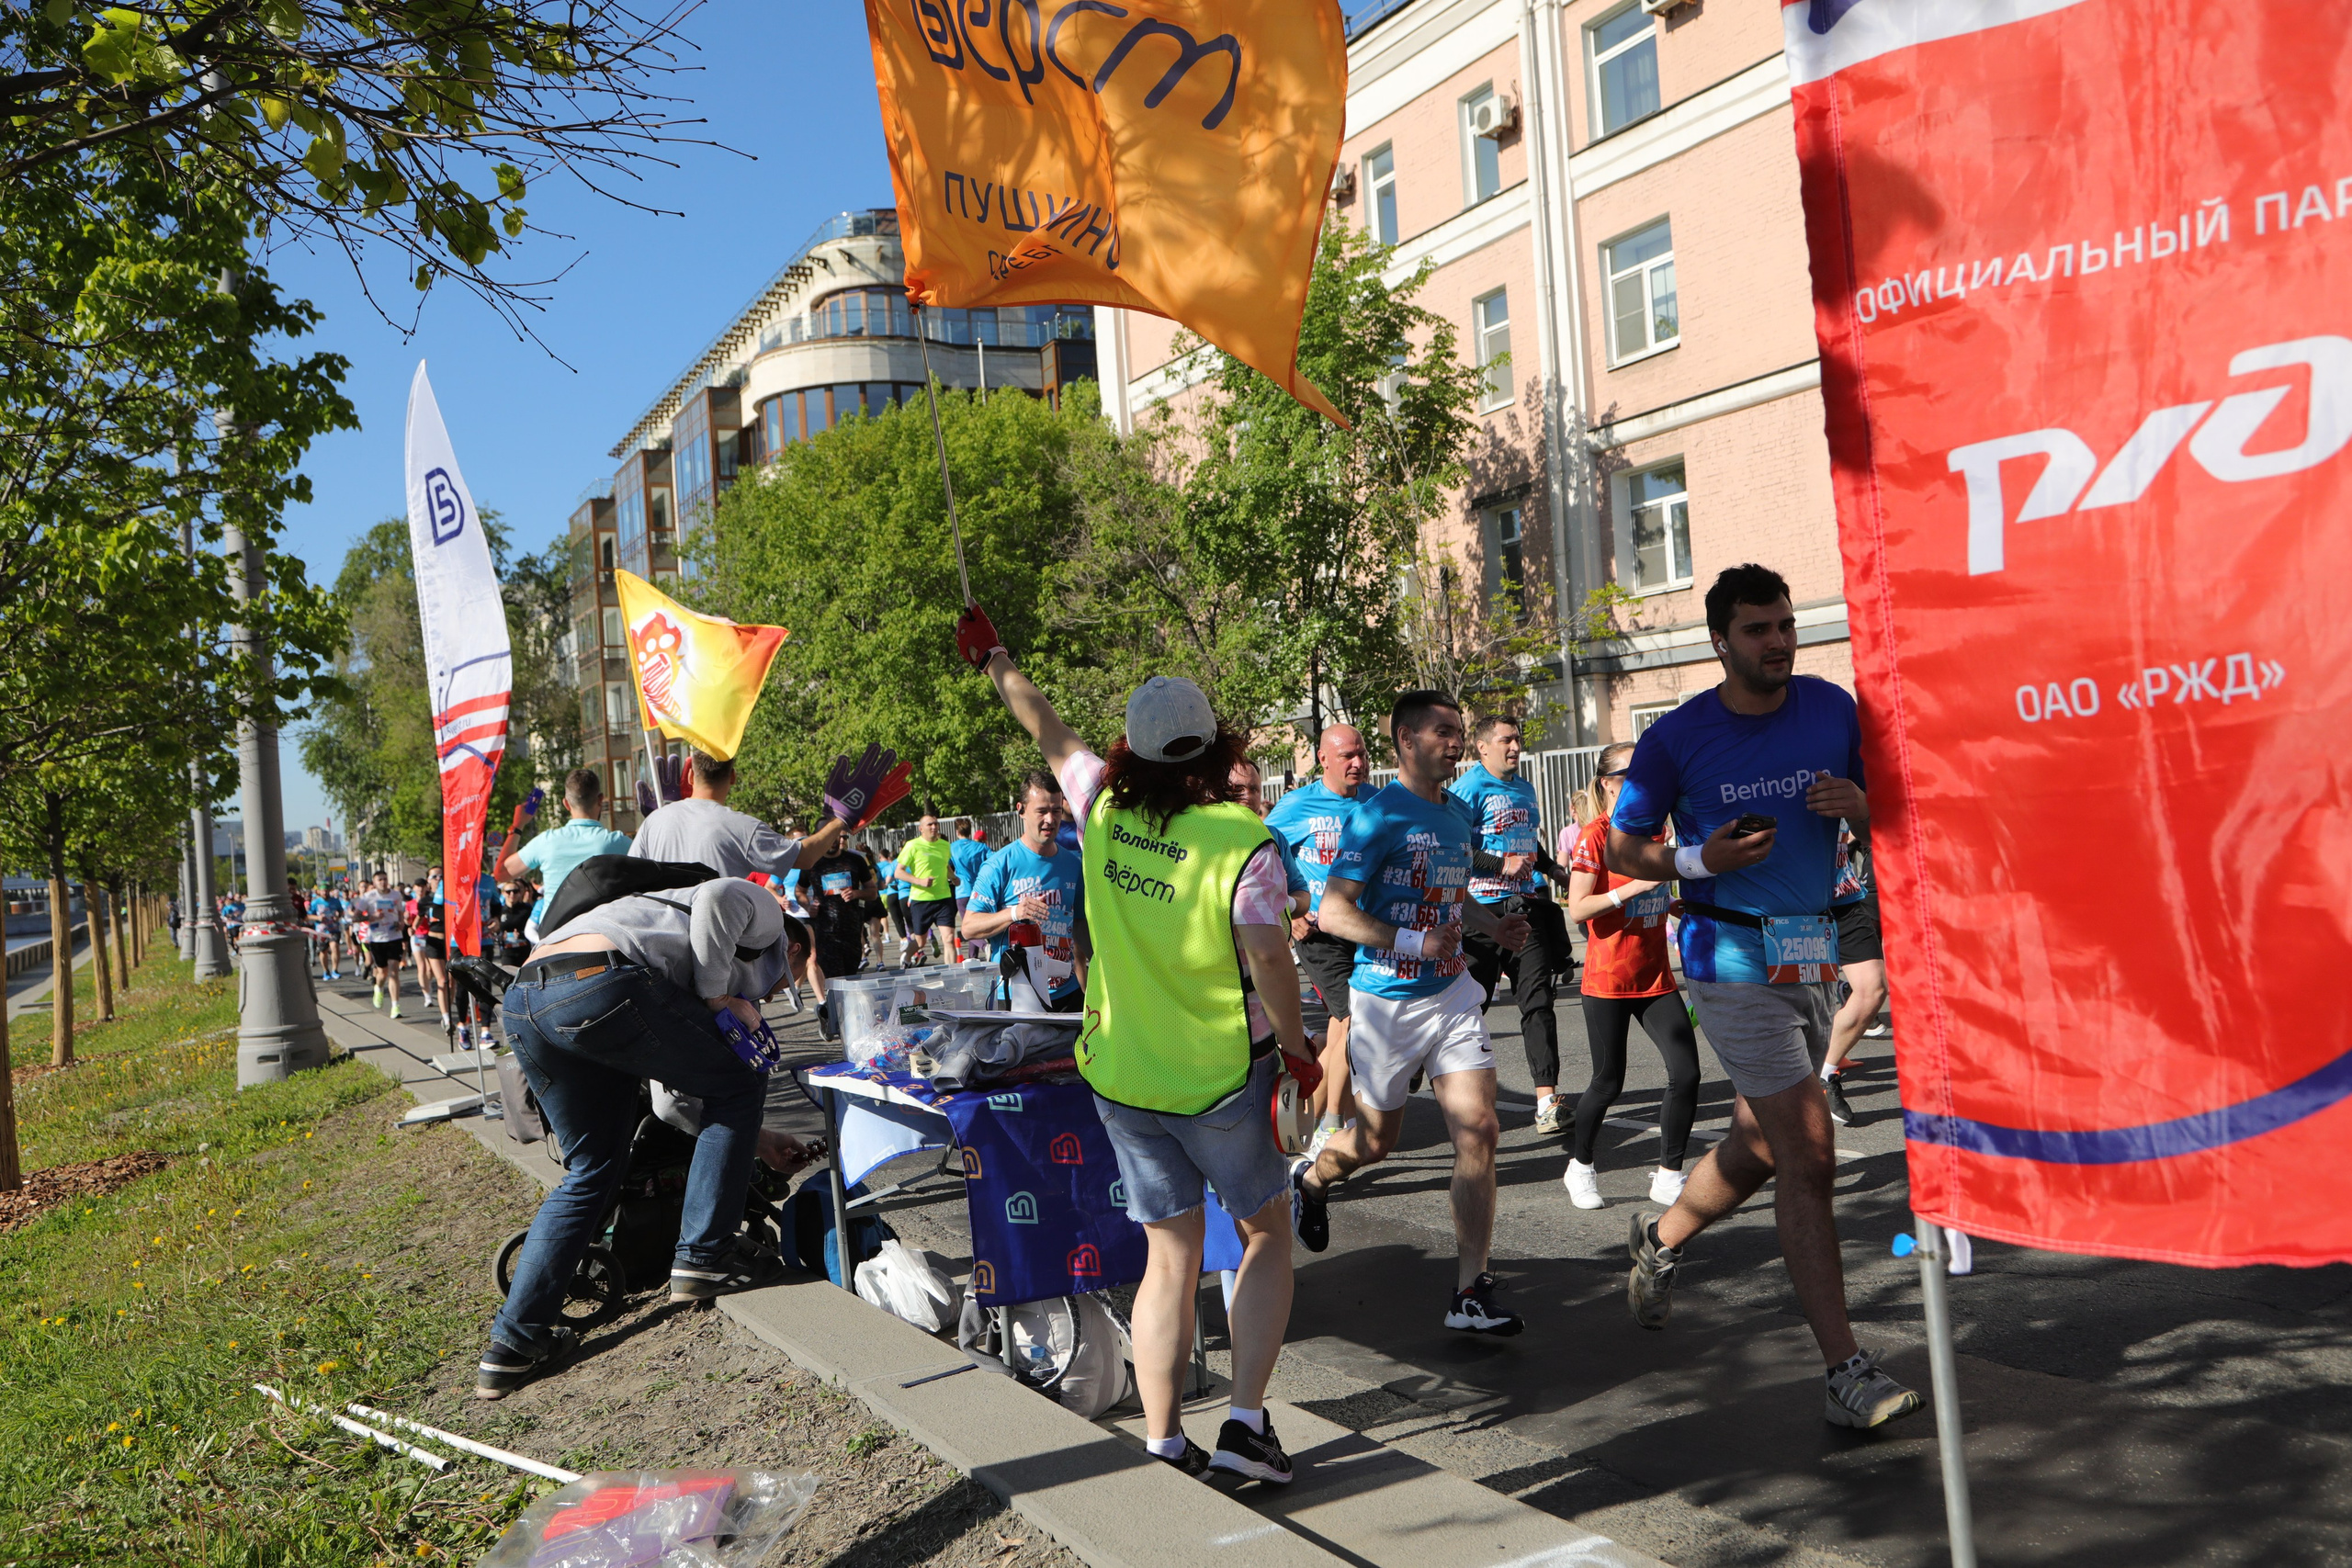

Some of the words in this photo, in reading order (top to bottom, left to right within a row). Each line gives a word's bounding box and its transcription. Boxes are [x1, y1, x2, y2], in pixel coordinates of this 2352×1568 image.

[1854, 196, 2231, 324] ОФИЦИАЛЬНЫЙ
[2015, 677, 2100, 723] ОАО
[2117, 652, 2287, 713] «РЖД»
[1485, 794, 1513, 811] 2024
[1309, 815, 1343, 834] 2024
[1112, 823, 1188, 863] Волонтёр
[1406, 832, 1441, 852] 2024
[1012, 875, 1043, 897] 2024
[1435, 865, 1465, 886] 27032
[1441, 886, 1457, 903] 5KM
[1781, 937, 1827, 962] 25095
[1798, 963, 1822, 983] 5KM
